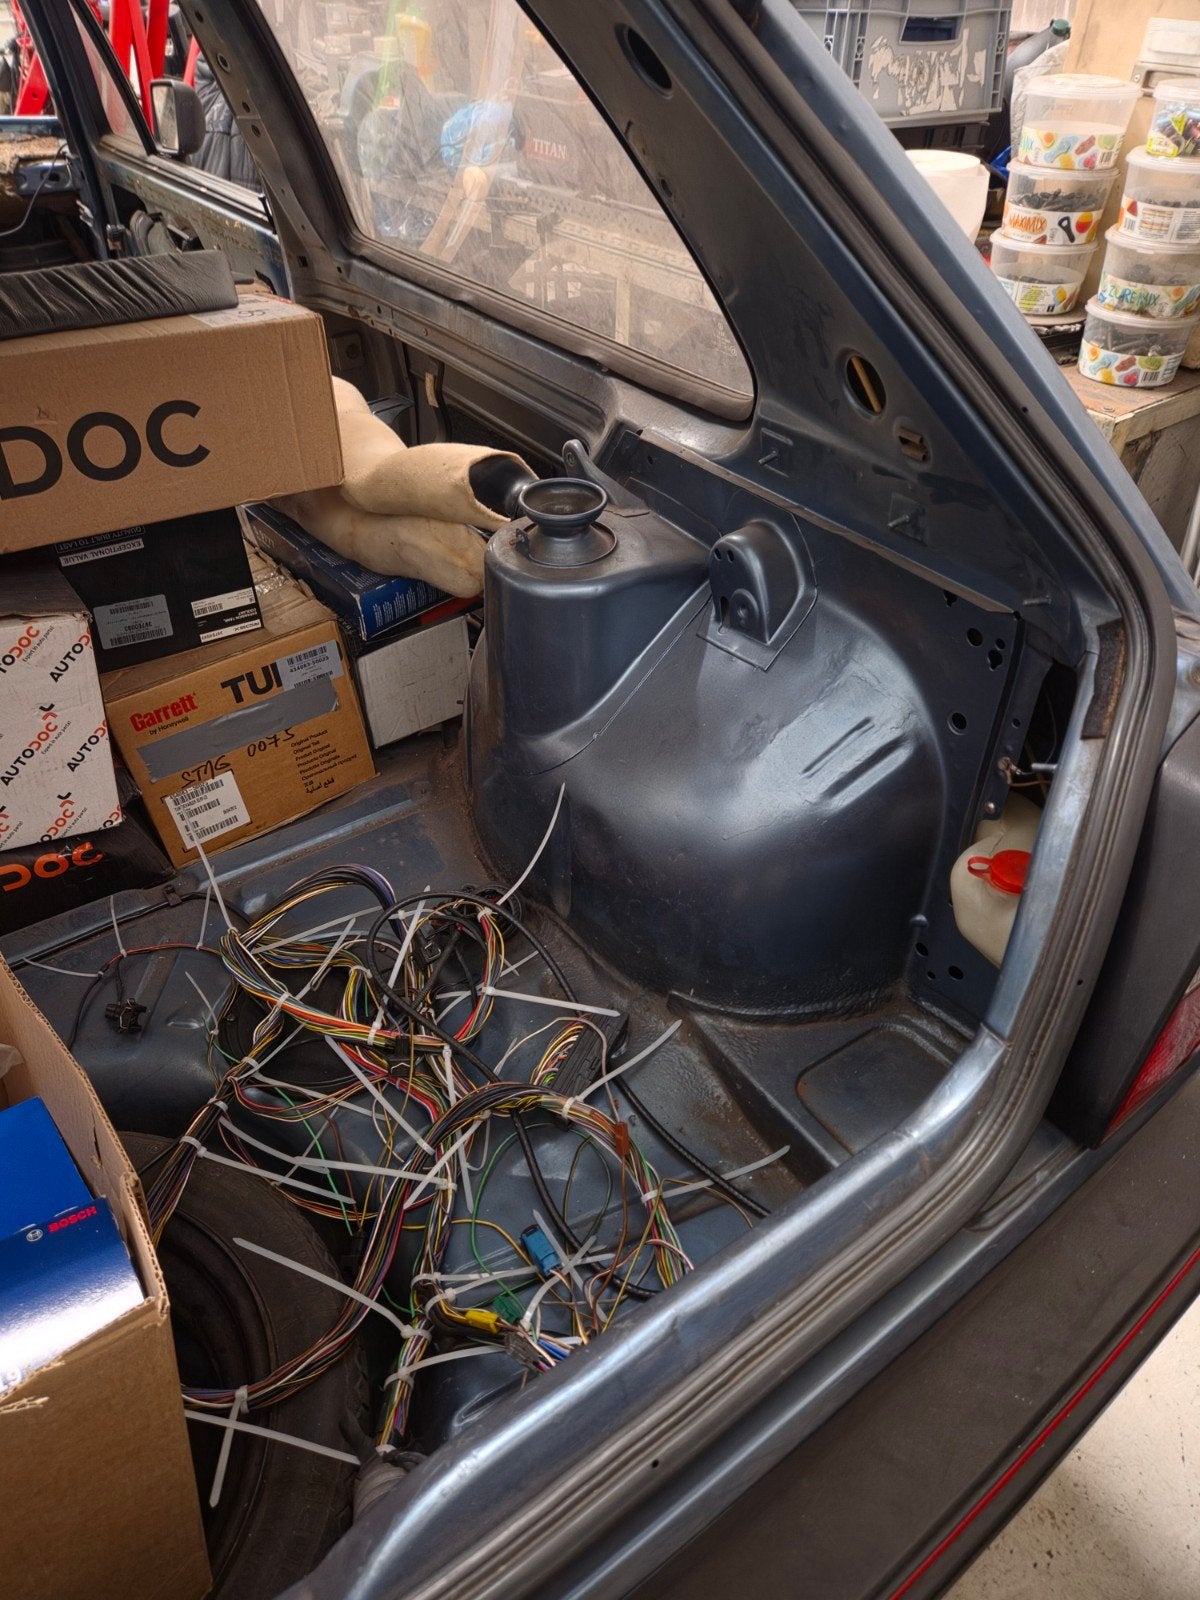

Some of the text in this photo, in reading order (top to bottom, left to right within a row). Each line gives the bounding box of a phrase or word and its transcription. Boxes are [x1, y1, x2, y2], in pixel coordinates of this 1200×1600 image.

[533, 137, 567, 160] TITAN
[0, 399, 211, 500] DOC
[64, 541, 142, 565] EXCEPTIONAL VALUE
[49, 626, 91, 683] AUTOD
[129, 694, 199, 732] Garrett
[149, 716, 190, 736] by Honeywell
[247, 727, 296, 757] 0075
[291, 729, 328, 748] Original Product
[293, 744, 312, 755] Original
[0, 721, 59, 787] AUTODOC
[0, 841, 104, 892] DOC
[48, 1205, 98, 1233] BOSCH
